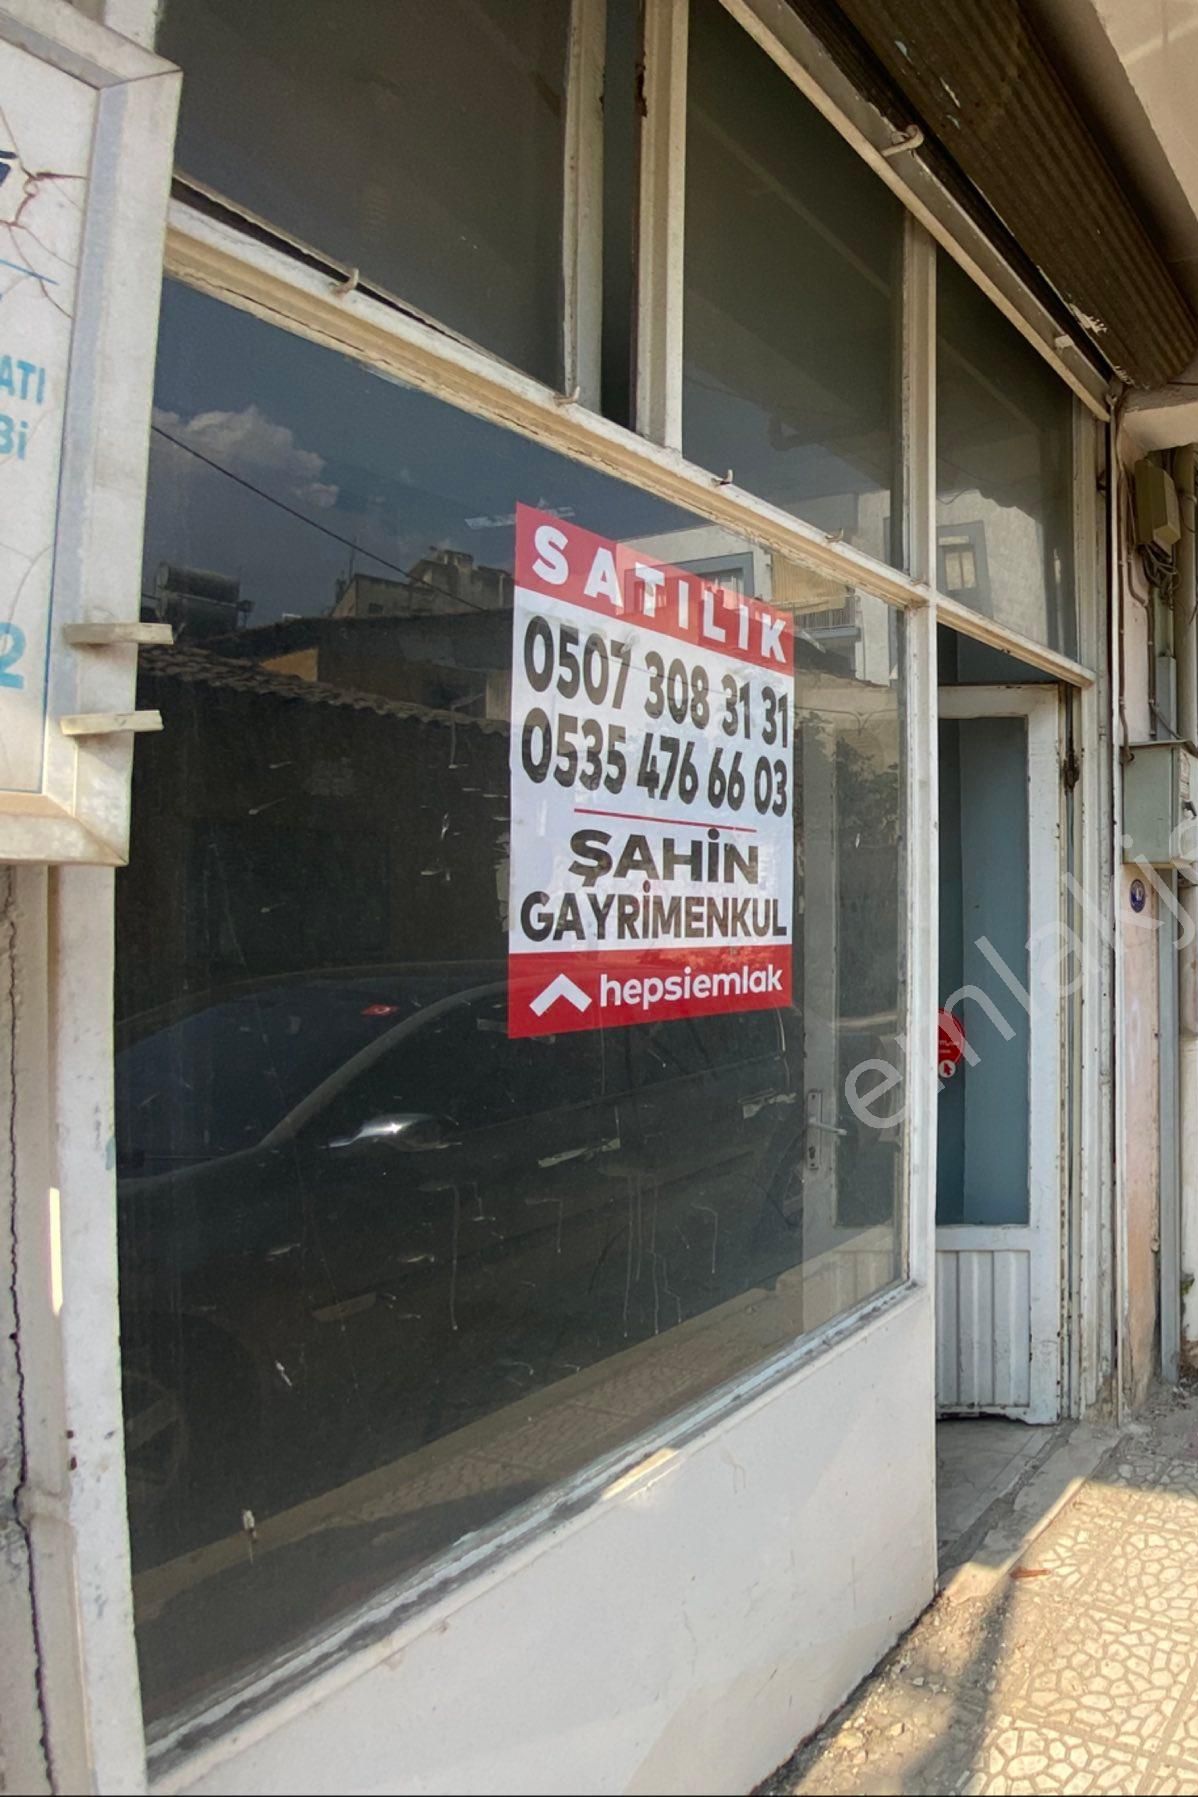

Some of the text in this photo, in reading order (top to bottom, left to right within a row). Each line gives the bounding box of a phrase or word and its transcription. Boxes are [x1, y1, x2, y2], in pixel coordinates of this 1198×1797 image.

[532, 525, 786, 663] SATILIK
[524, 615, 787, 748] 0507 308 31 31
[522, 707, 787, 817] 0535 476 66 03
[568, 828, 758, 887] ŞAHİN
[520, 880, 787, 942] GAYRİMENKUL
[600, 964, 783, 1010] hepsiemlak
